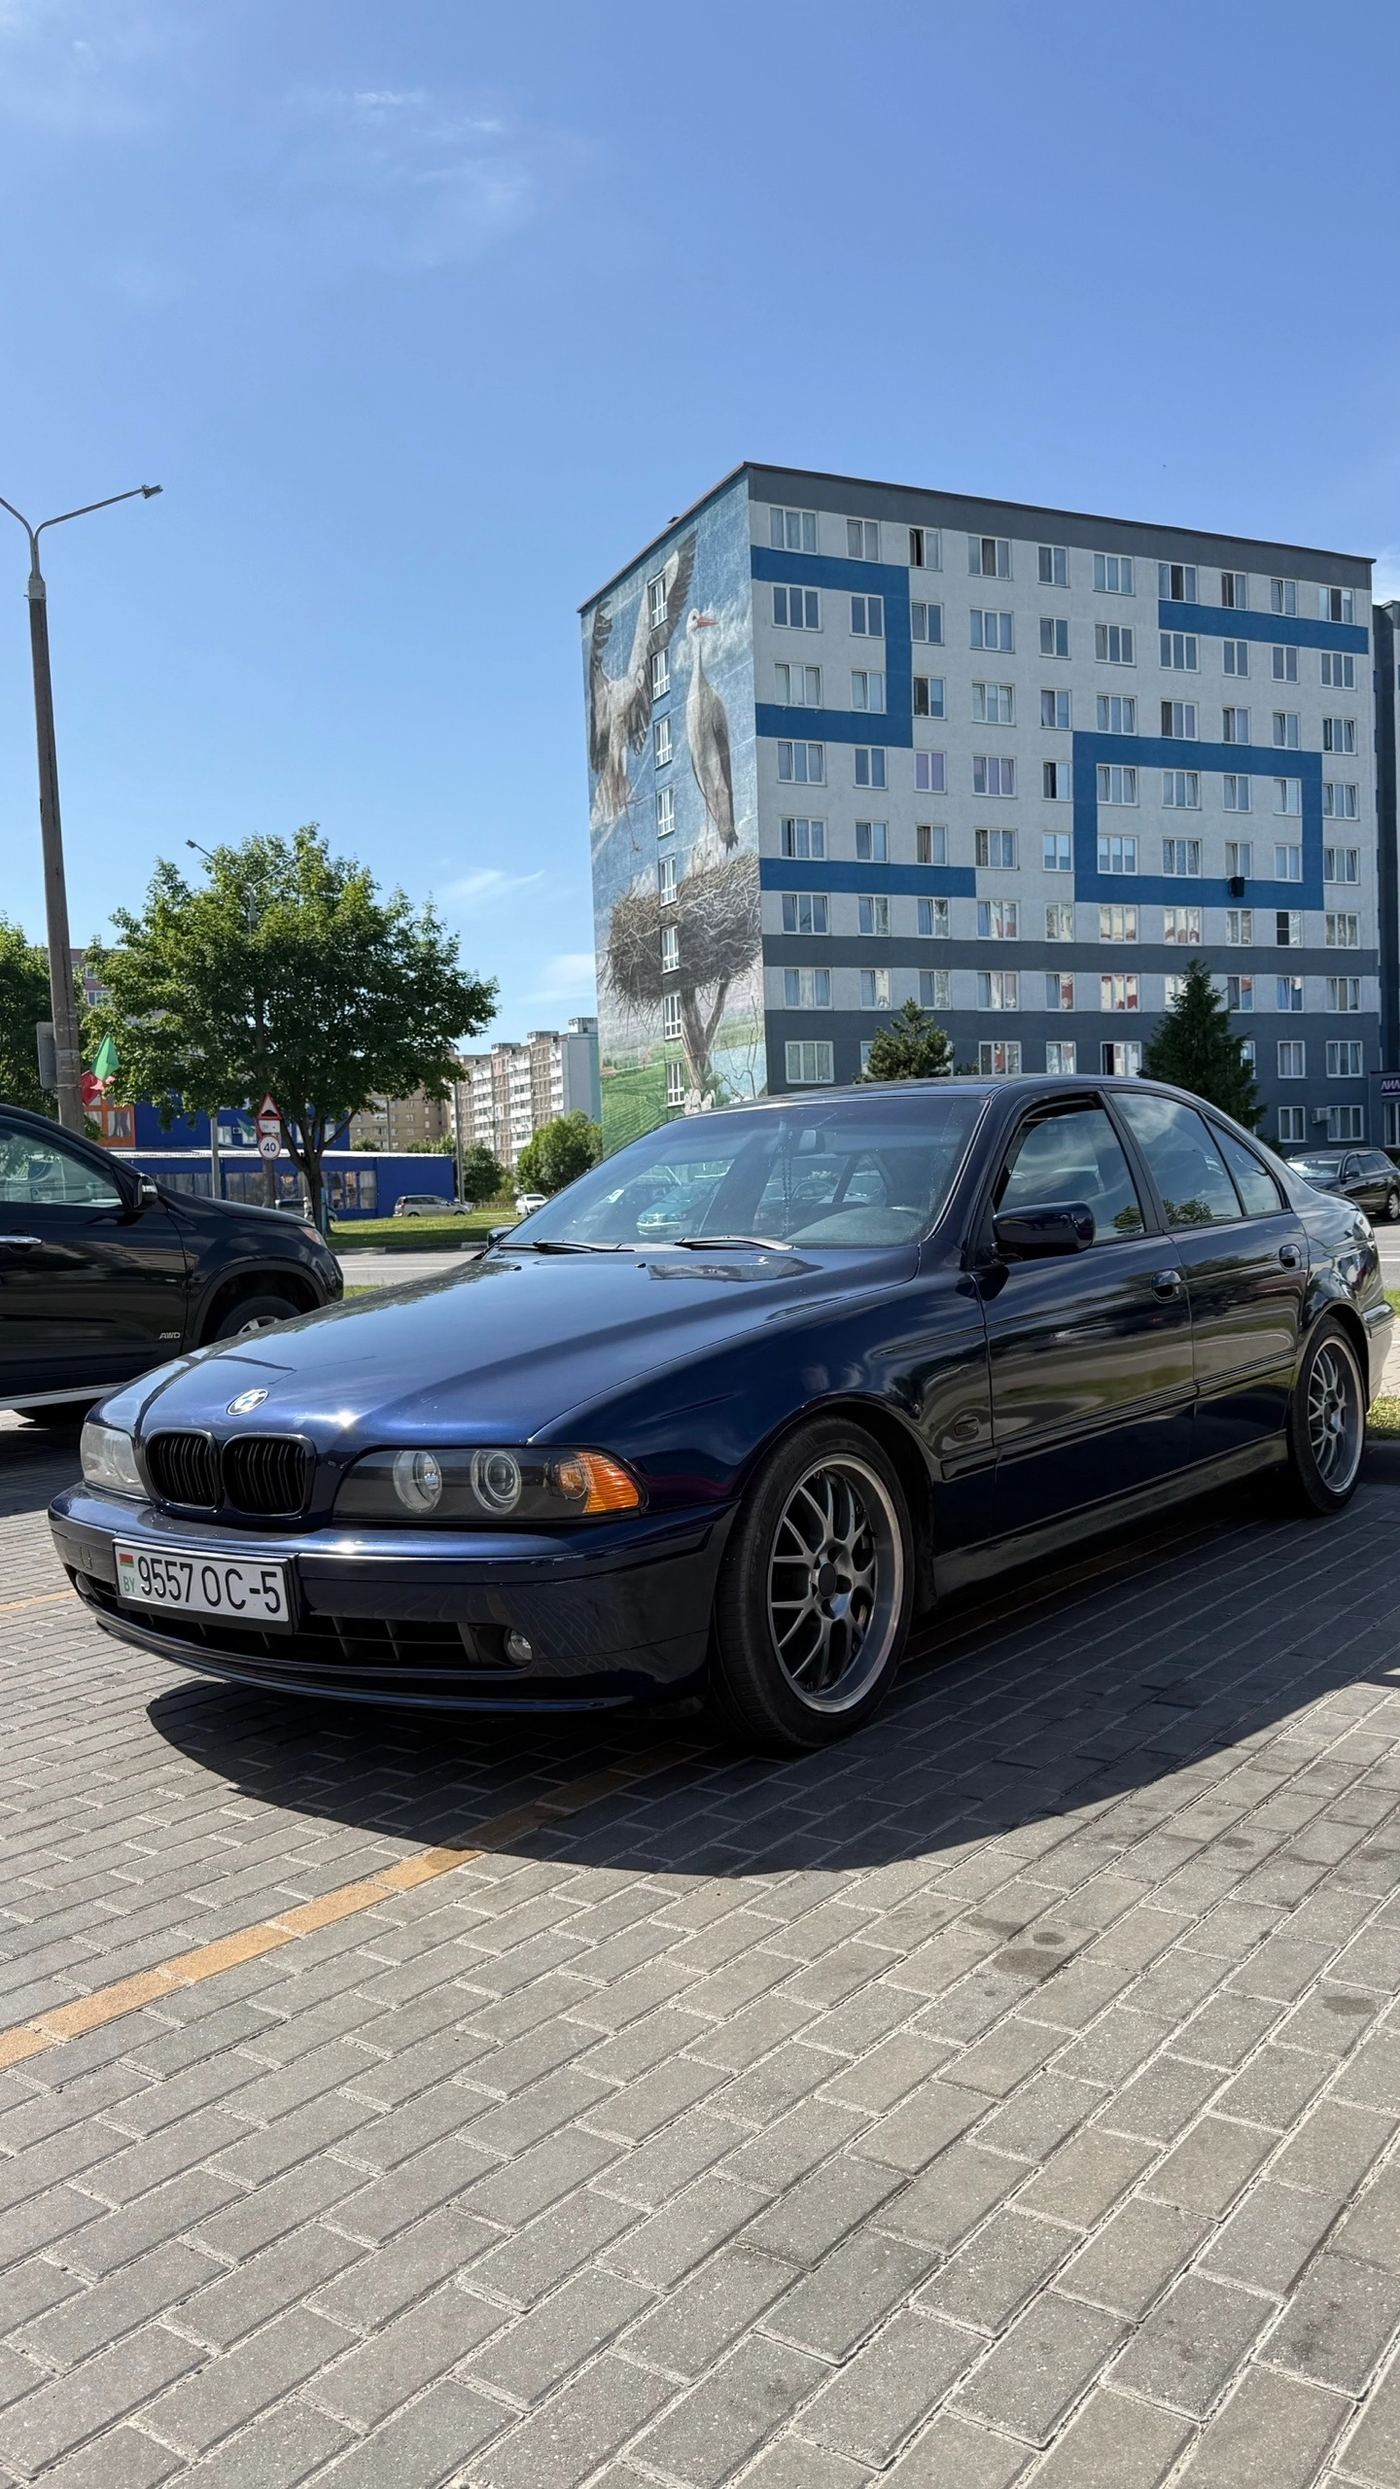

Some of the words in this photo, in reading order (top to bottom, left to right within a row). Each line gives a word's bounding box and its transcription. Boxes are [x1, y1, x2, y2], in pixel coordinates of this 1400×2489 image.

[263, 1142, 276, 1152] 40
[159, 1331, 181, 1339] AWD
[123, 1575, 135, 1593] BY
[138, 1556, 193, 1603] 9557
[201, 1565, 280, 1614] OC-5
